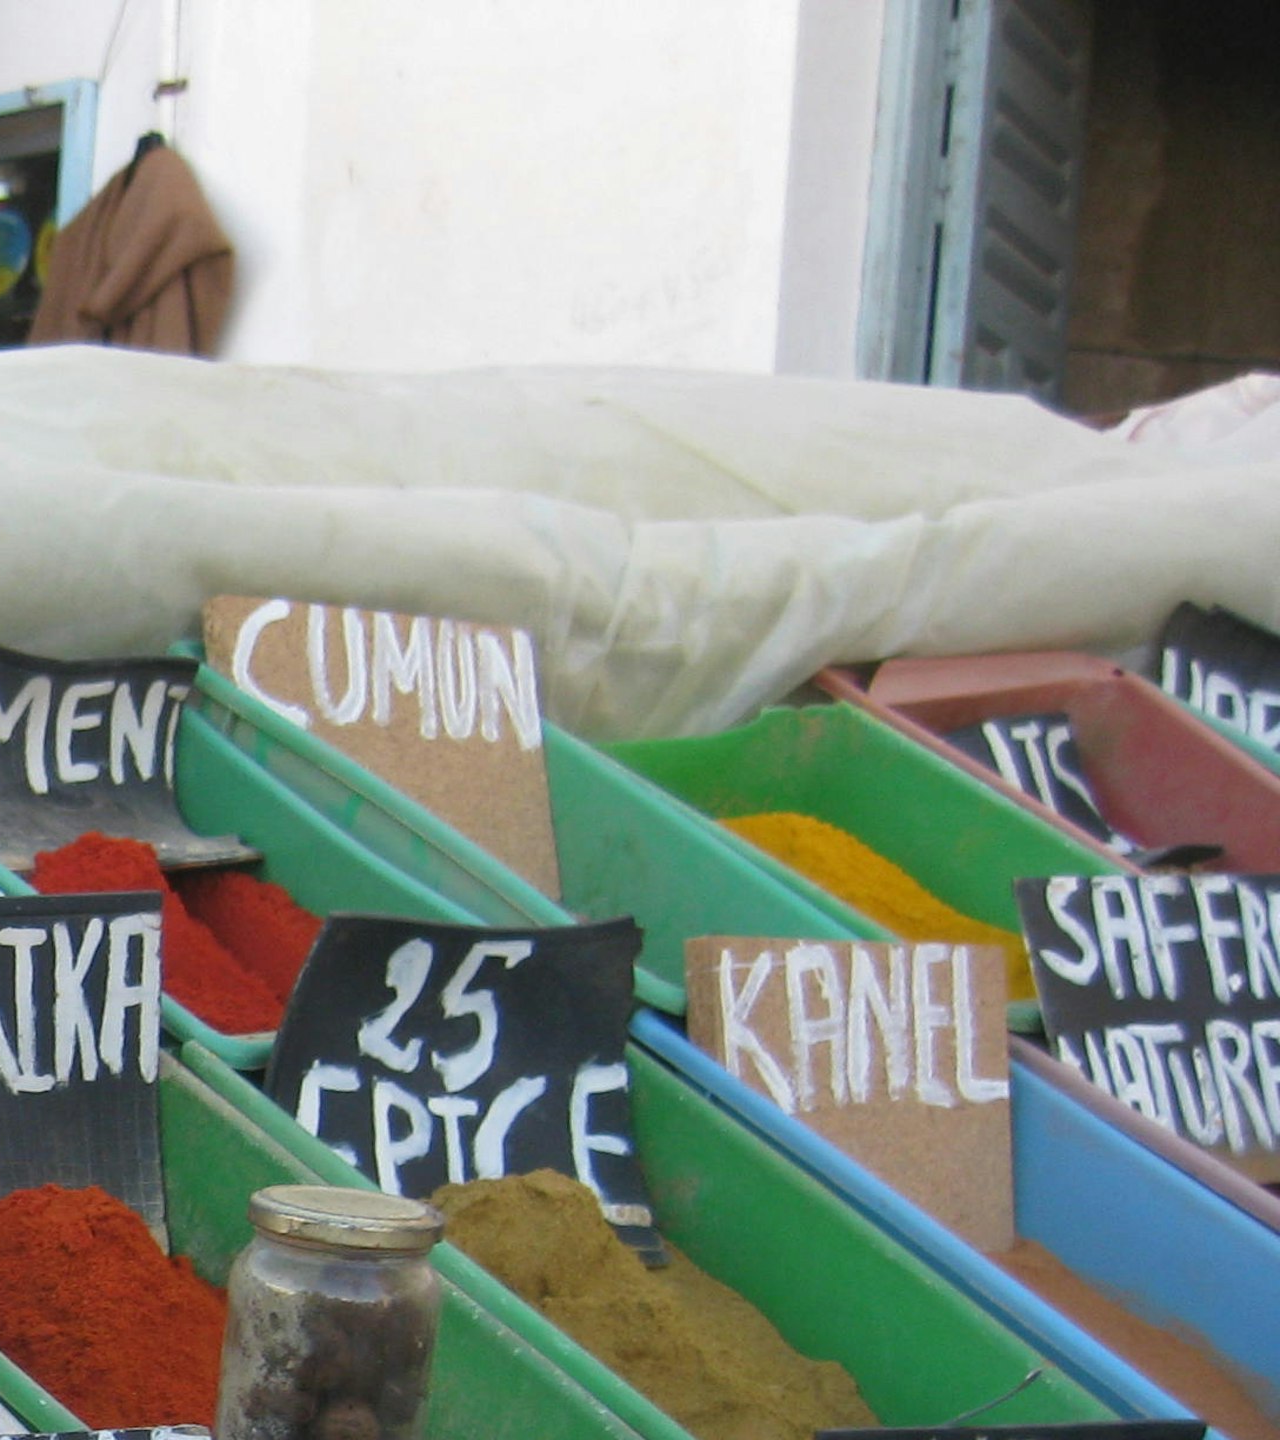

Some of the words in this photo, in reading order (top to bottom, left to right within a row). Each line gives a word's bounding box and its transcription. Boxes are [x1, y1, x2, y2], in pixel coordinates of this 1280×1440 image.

[357, 937, 534, 1094] 25
[1039, 875, 1280, 1005] SAFFR
[720, 941, 1009, 1116] KANEL
